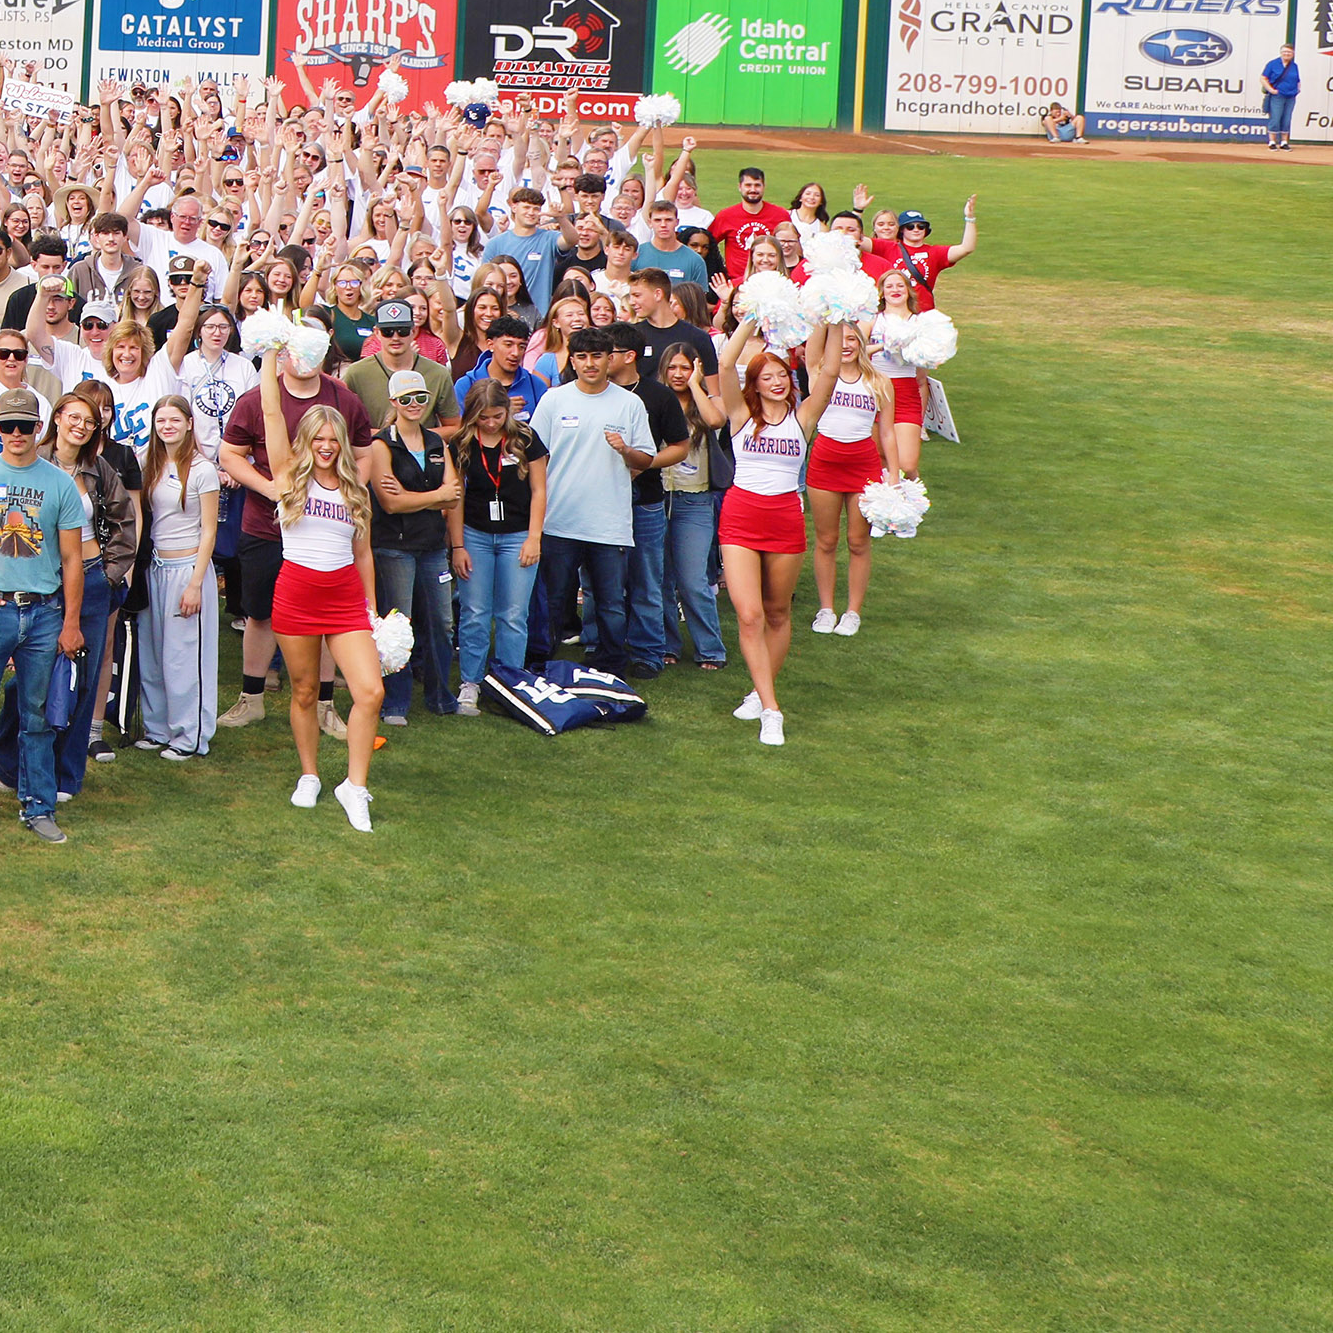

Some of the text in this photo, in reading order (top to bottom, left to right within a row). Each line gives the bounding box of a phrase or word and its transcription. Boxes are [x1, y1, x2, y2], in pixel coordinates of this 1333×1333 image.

[1011, 3, 1069, 11] CANYON
[35, 12, 53, 23] P.S.
[930, 1, 1073, 35] GRAND
[121, 14, 243, 38] CATALYST
[741, 18, 805, 40] Idaho
[48, 39, 74, 51] MD
[137, 35, 225, 51] Medical Group
[340, 43, 389, 55] SINCE 1958
[490, 25, 579, 61] DR
[958, 36, 1043, 47] HOTEL
[739, 39, 827, 61] Central
[44, 58, 68, 70] DO
[493, 60, 611, 75] DISASTER
[739, 64, 826, 75] CREDIT UNION
[100, 68, 170, 83] LEWISTON
[494, 74, 610, 89] RESPONSE
[898, 73, 1068, 96] 208-799-1000
[1124, 76, 1243, 94] SUBARU
[5, 83, 73, 105] Welcome
[4, 97, 21, 109] LC
[1096, 100, 1230, 113] We CARE About What You're
[1097, 118, 1267, 139] rogerssubaru.com
[743, 434, 801, 456] WARRIORS
